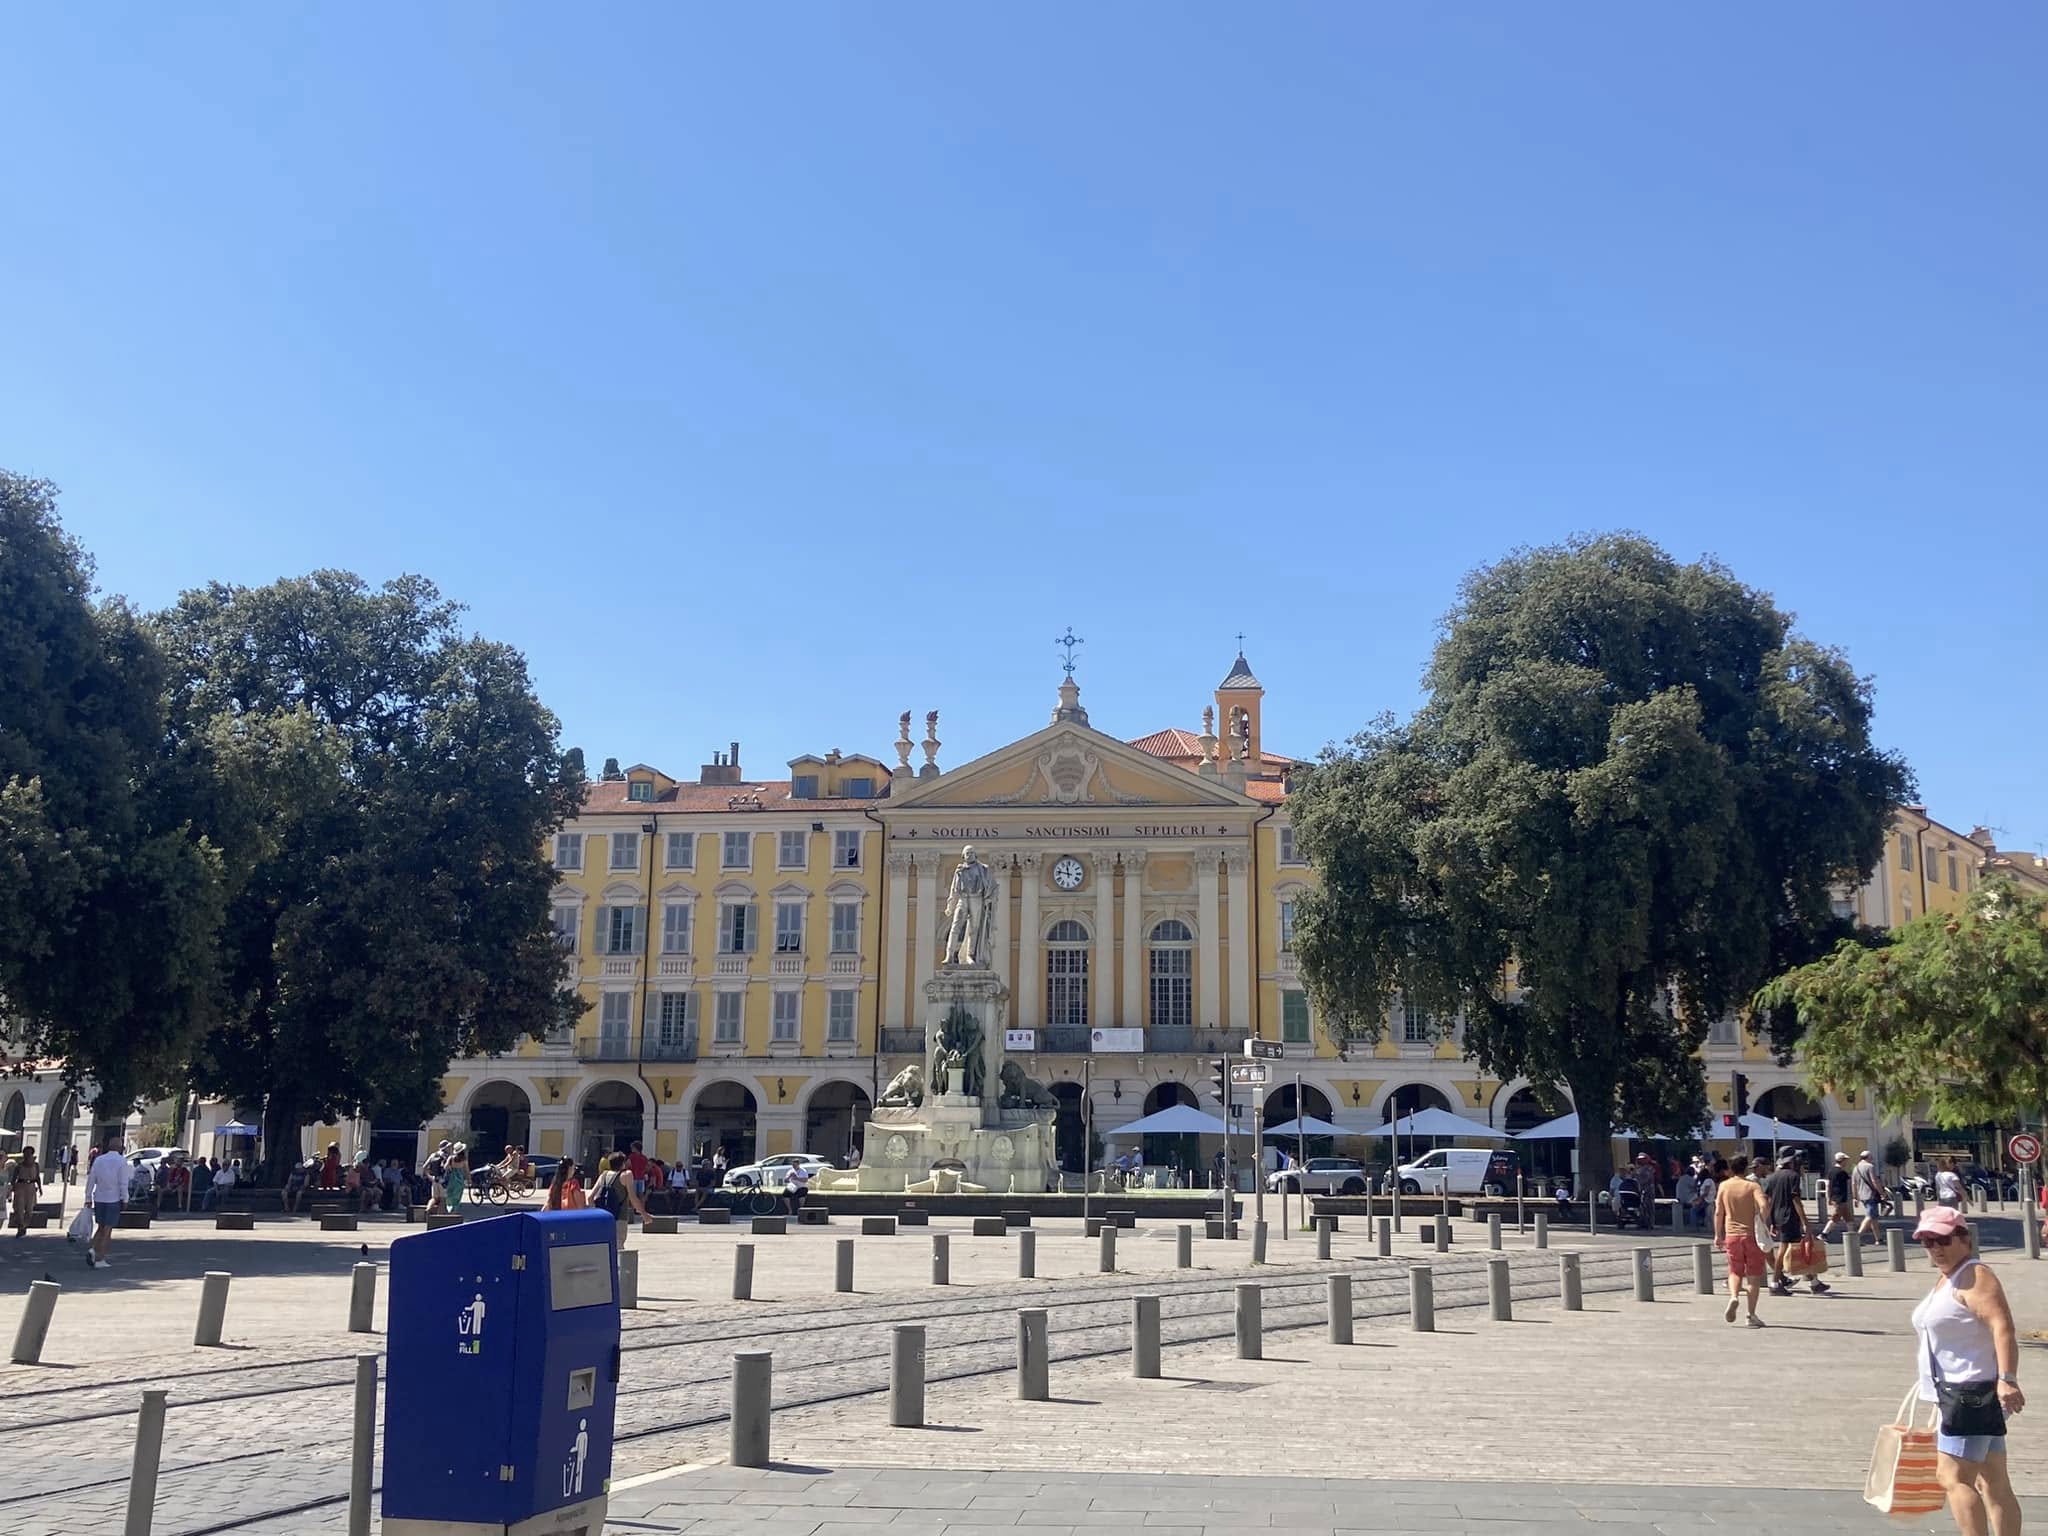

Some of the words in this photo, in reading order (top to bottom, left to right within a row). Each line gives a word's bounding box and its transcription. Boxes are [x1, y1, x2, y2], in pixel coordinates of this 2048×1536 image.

[931, 826, 999, 837] SOCIETAS
[1025, 826, 1110, 837] SANCTISSIMI
[1135, 825, 1205, 835] SEPULCRI
